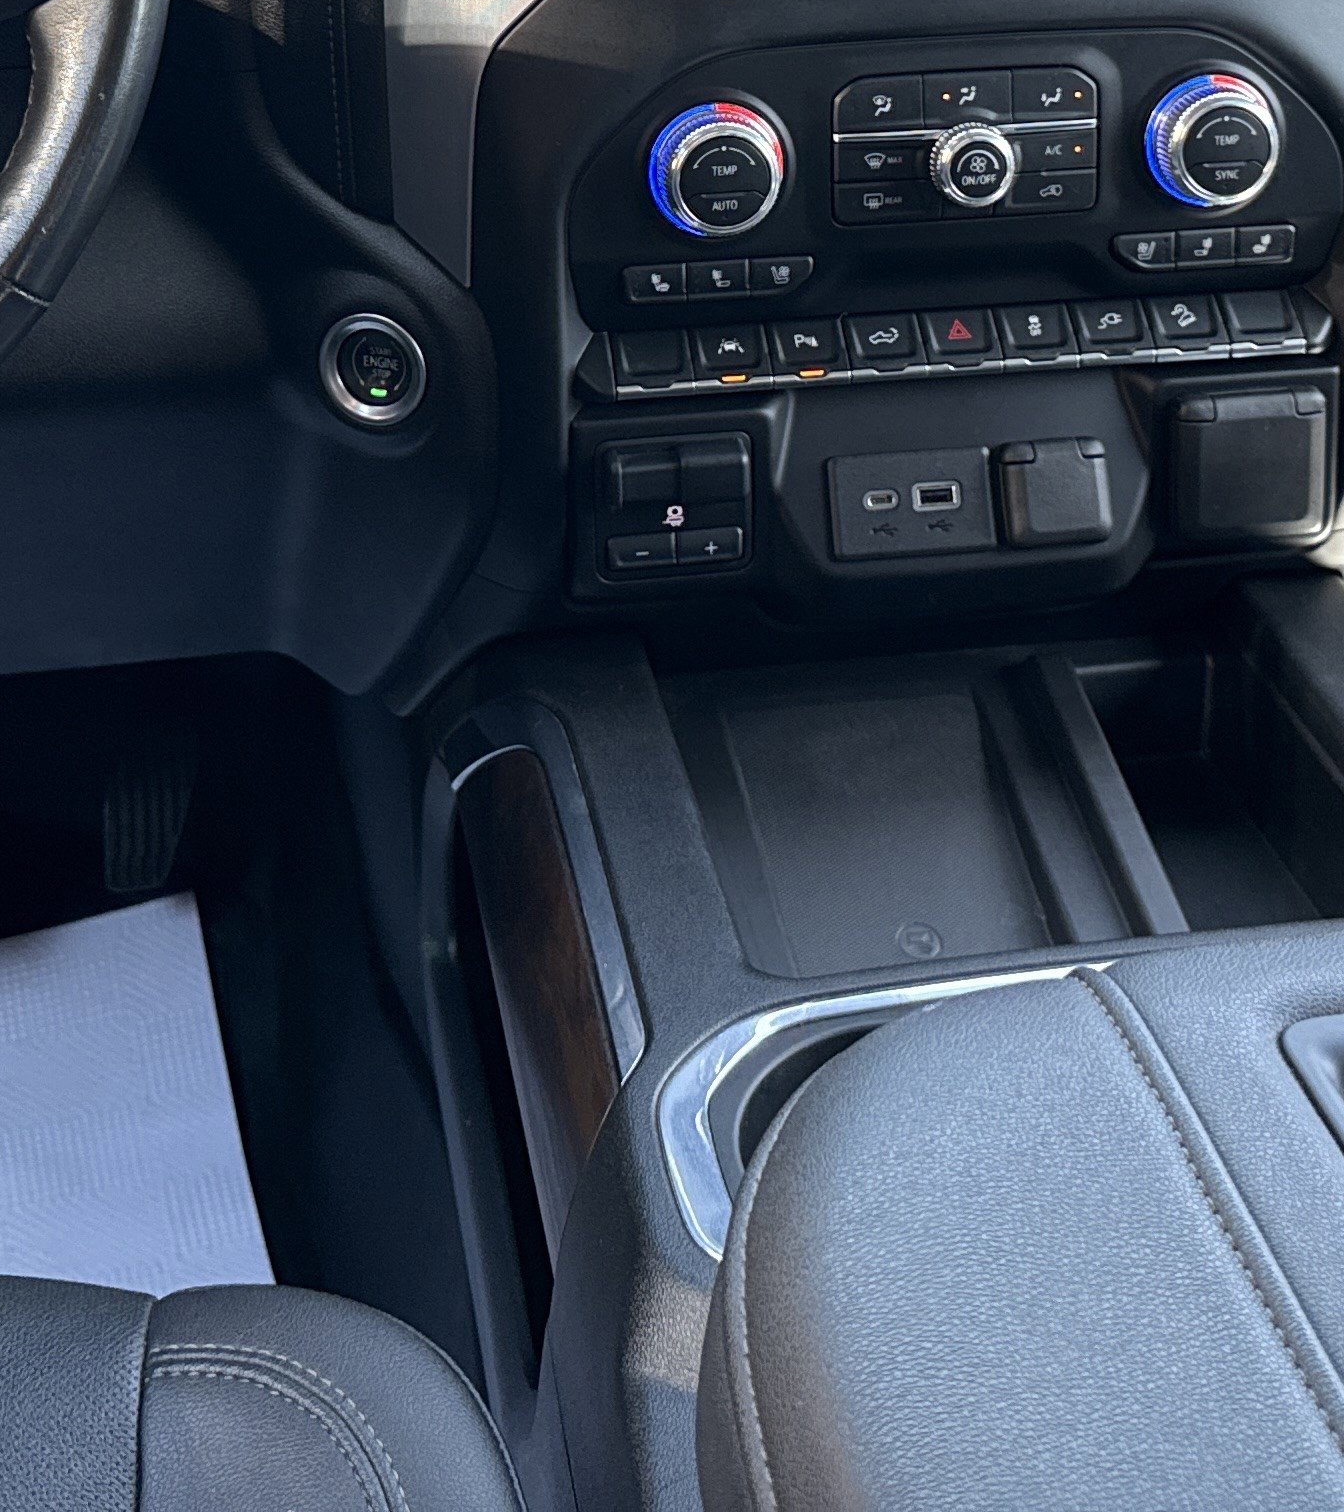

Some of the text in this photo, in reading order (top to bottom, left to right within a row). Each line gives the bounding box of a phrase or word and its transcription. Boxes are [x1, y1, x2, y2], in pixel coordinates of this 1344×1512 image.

[1214, 135, 1240, 146] TEMP
[1045, 145, 1063, 156] A/C
[712, 165, 737, 176] TEMP
[1215, 169, 1239, 180] SYNC
[961, 174, 997, 186] ON/OFF
[712, 200, 738, 211] AUTO
[363, 355, 400, 371] ENGINE
